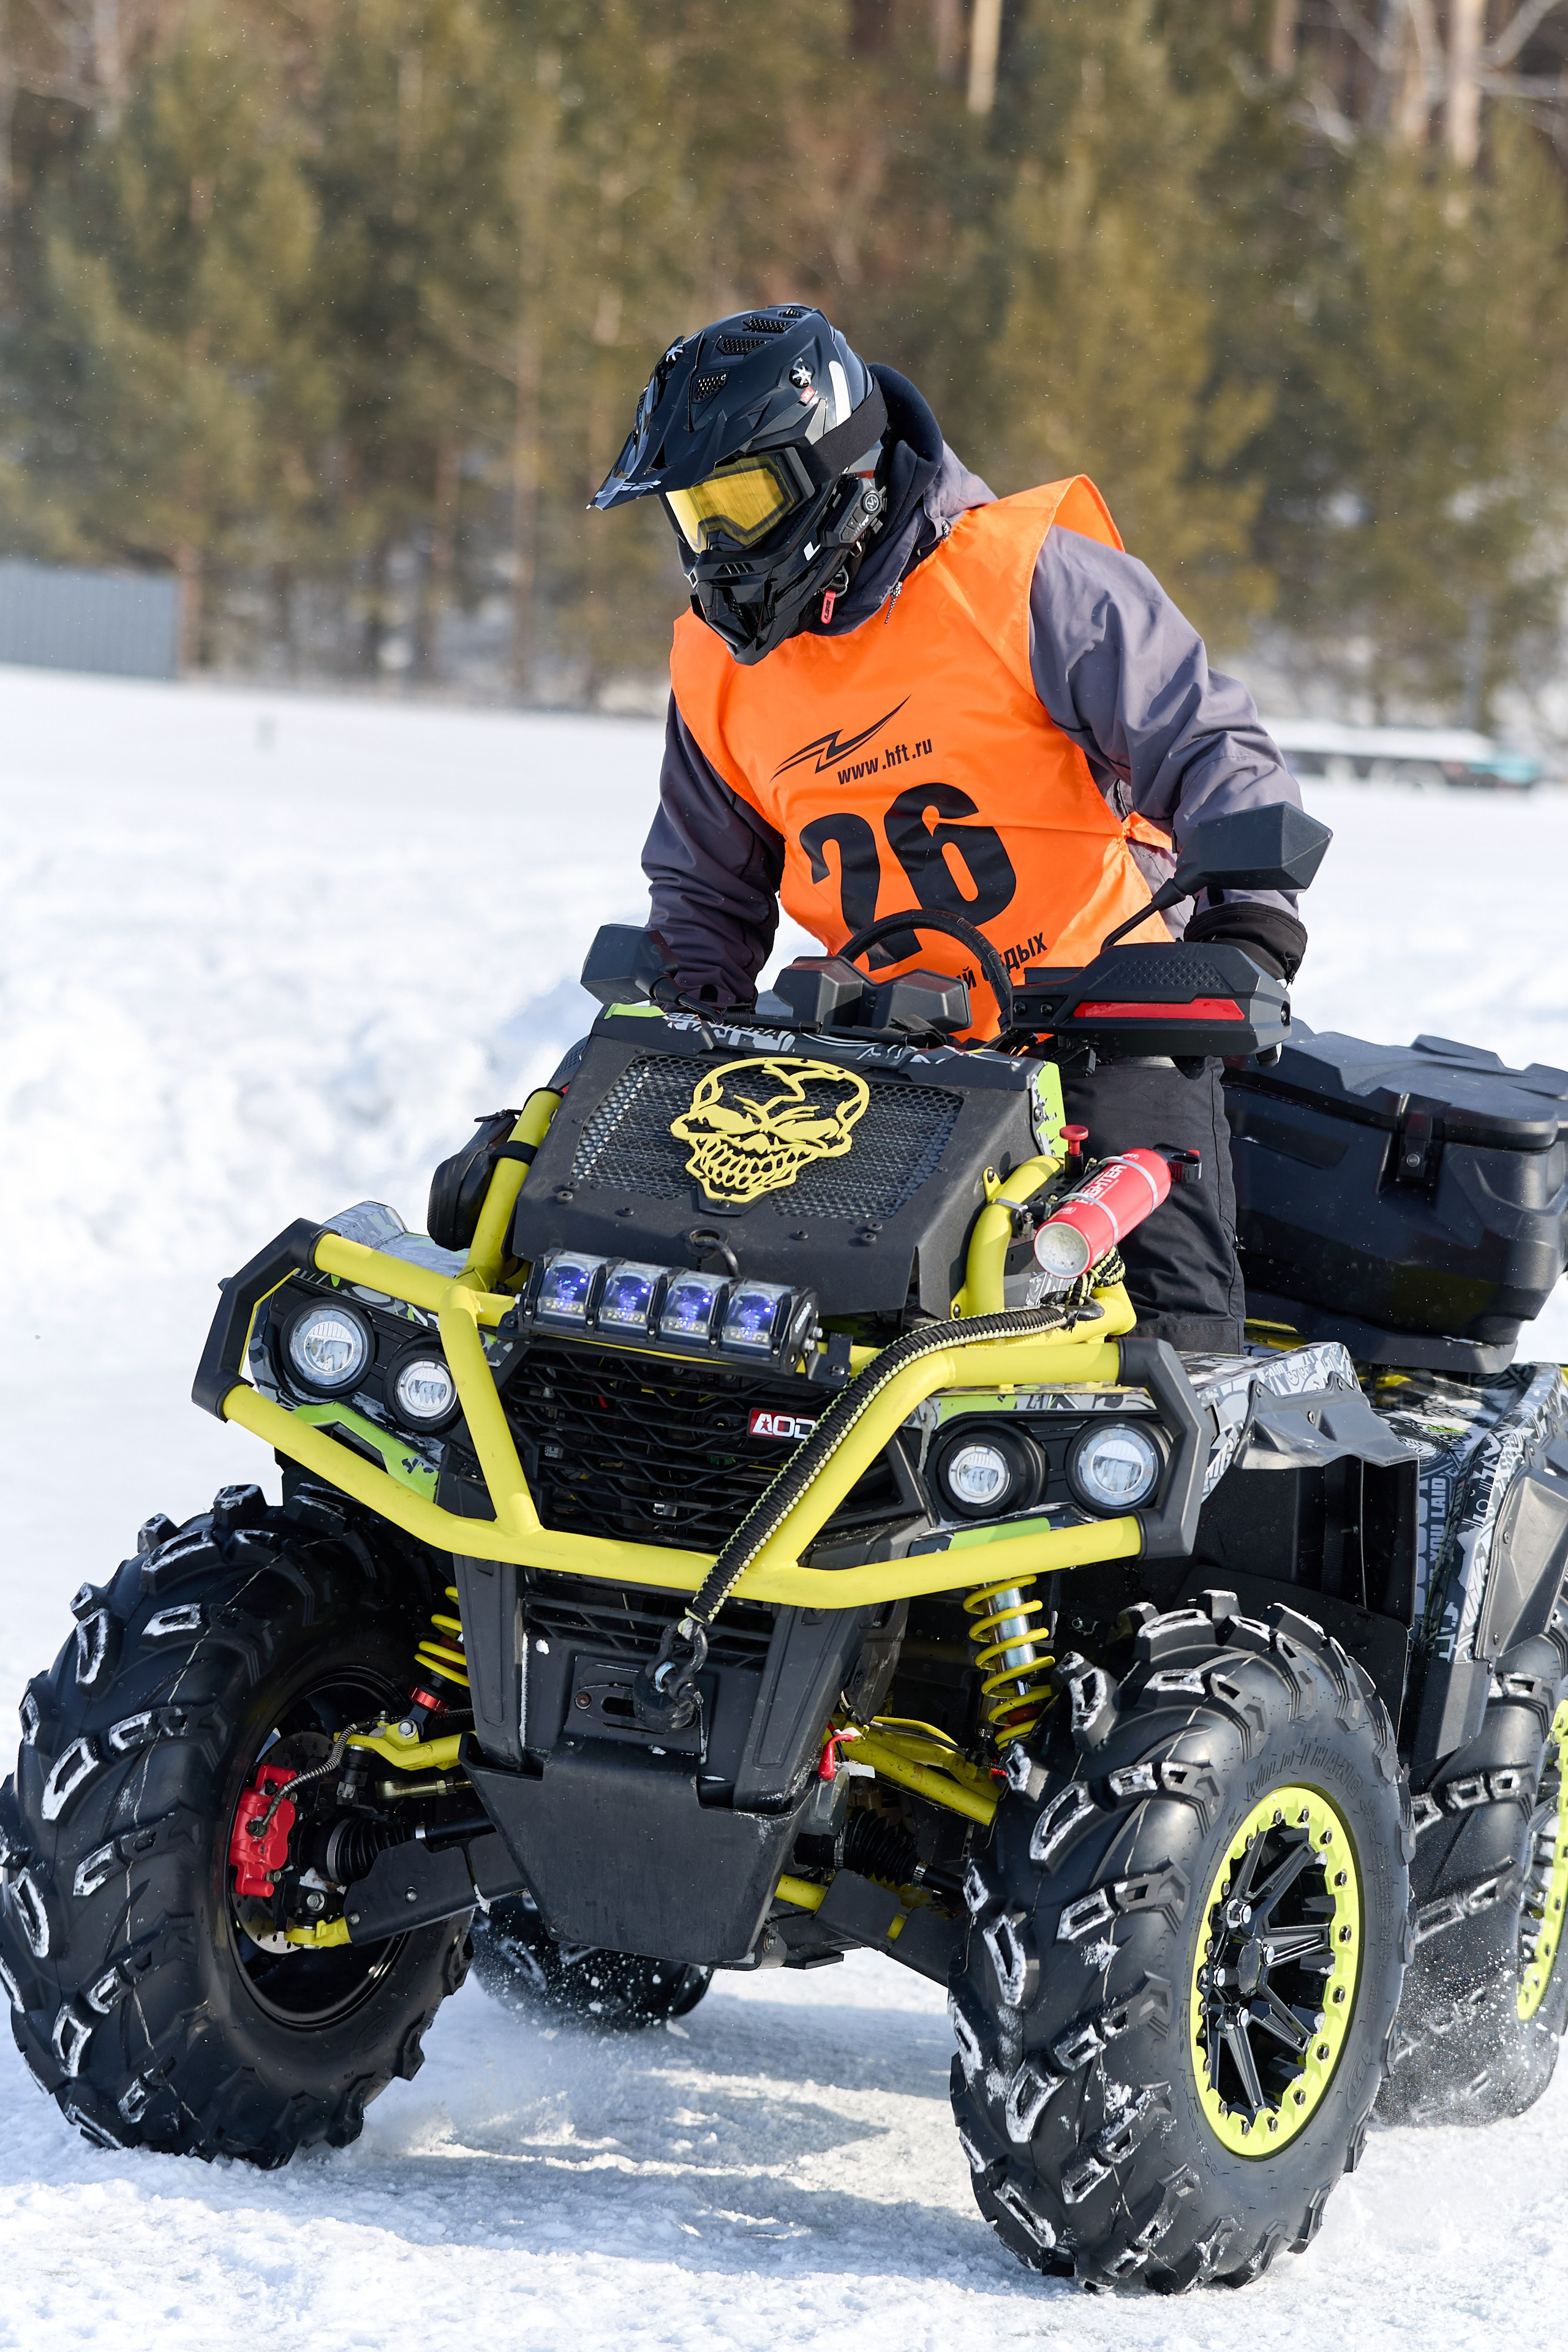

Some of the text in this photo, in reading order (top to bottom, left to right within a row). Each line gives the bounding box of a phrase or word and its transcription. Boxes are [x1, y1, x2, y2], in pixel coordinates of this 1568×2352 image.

[837, 738, 933, 785] www.hft.ru
[799, 782, 1016, 972] 26
[981, 932, 1048, 982] ДЫХ
[1430, 1477, 1447, 1518] LAID
[1299, 1736, 1363, 1799] THANG
